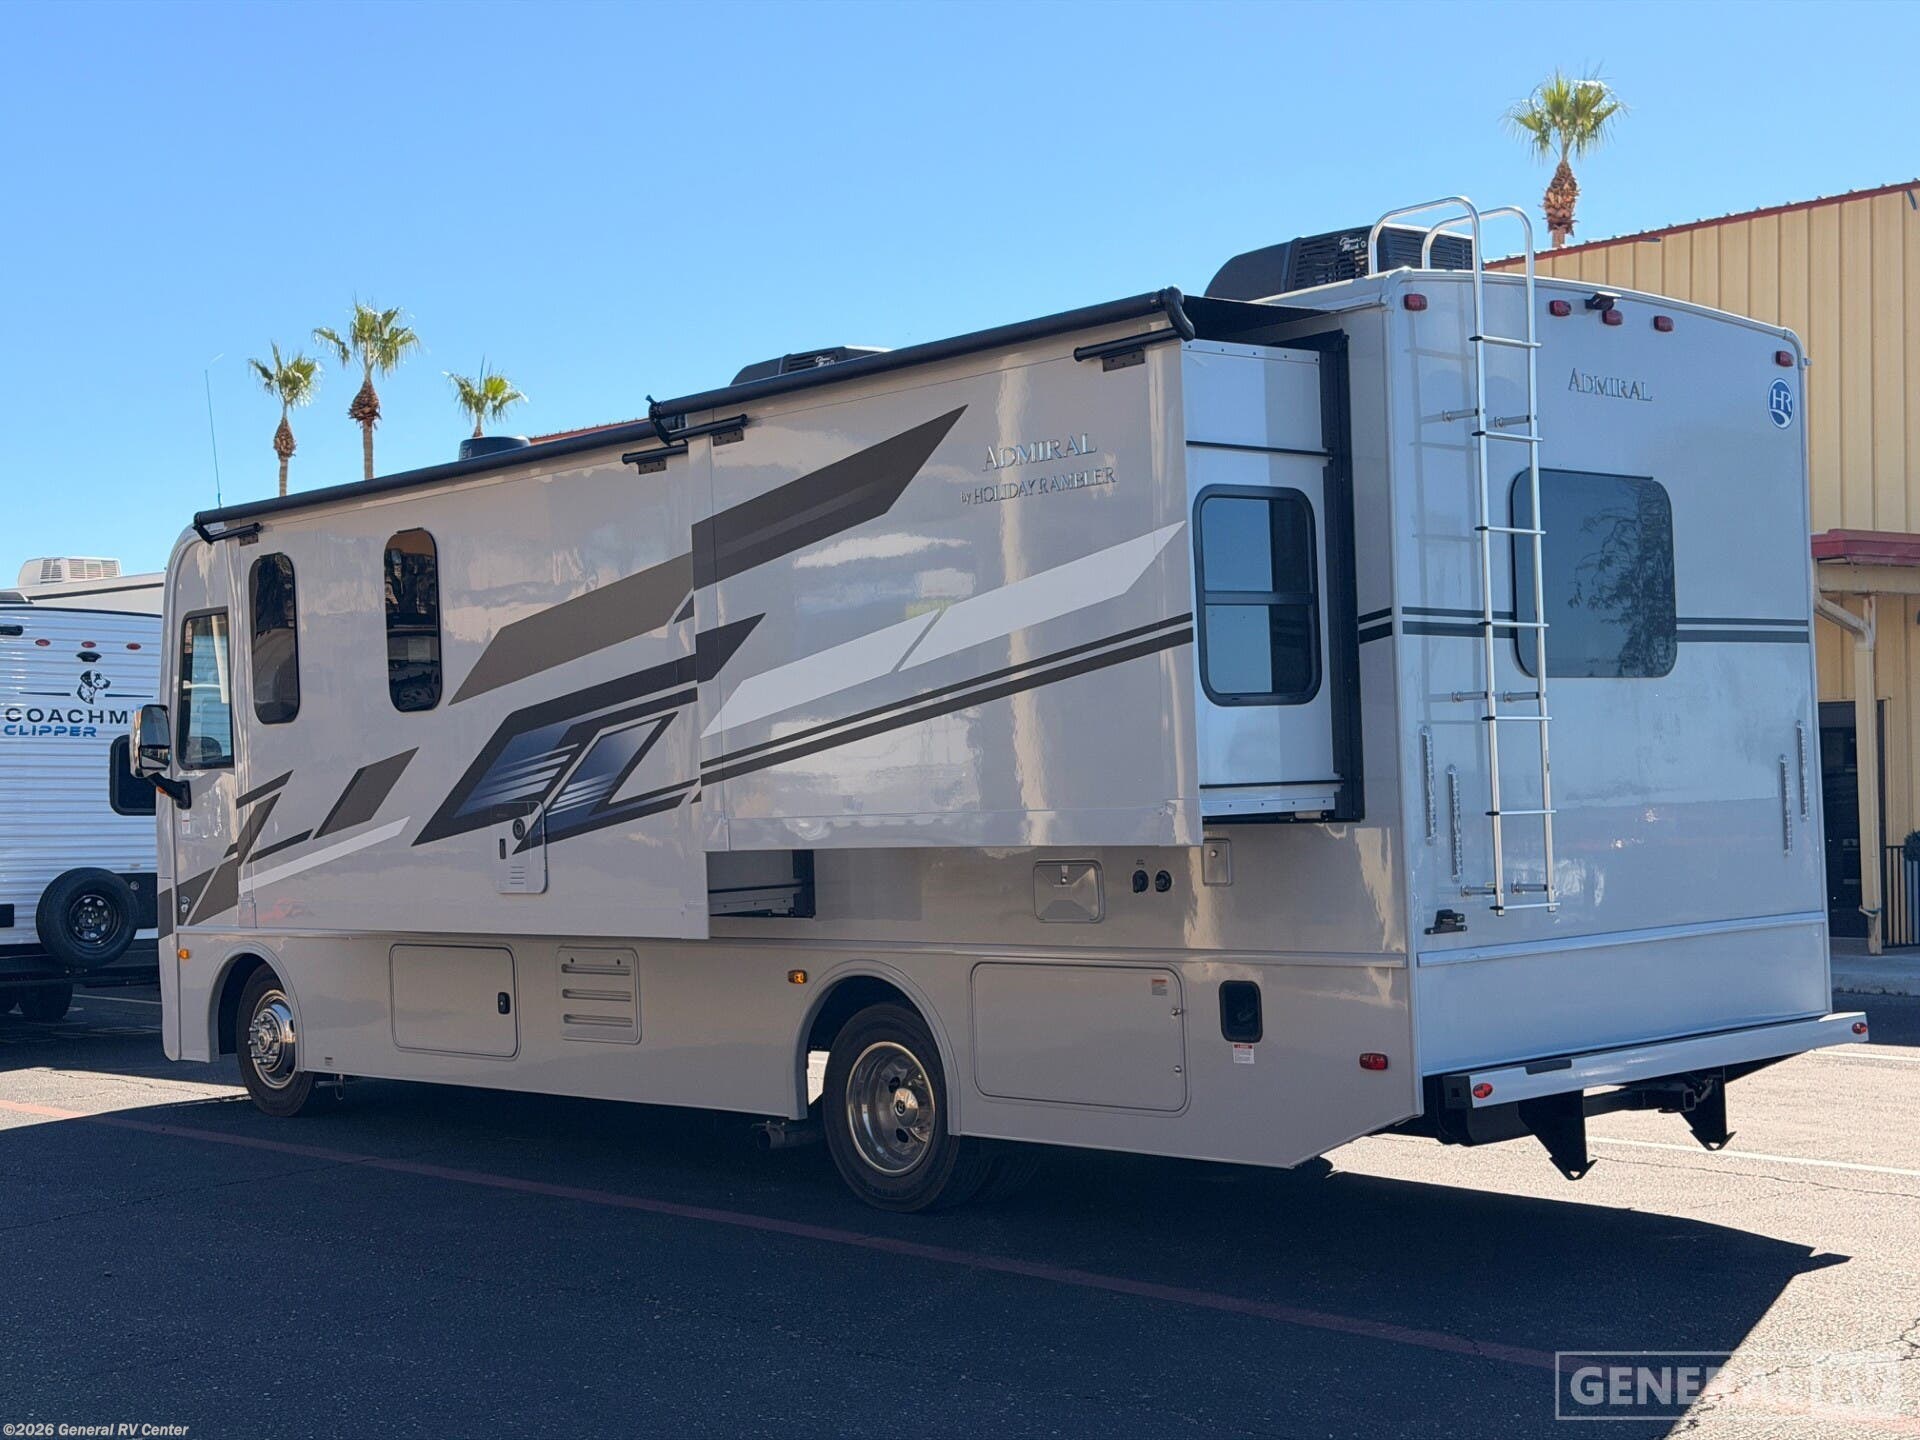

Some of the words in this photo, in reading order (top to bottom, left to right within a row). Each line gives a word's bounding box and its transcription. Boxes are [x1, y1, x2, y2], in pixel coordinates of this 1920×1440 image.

[1568, 367, 1653, 402] ADMIRAL
[1772, 388, 1792, 412] HR
[982, 432, 1098, 472] ADMIRAL
[961, 490, 972, 505] by
[973, 478, 1038, 505] HOLIDAY
[1038, 466, 1119, 495] RAMBLER
[4, 724, 97, 737] CLIPPER
[5, 708, 135, 724] COACHM
